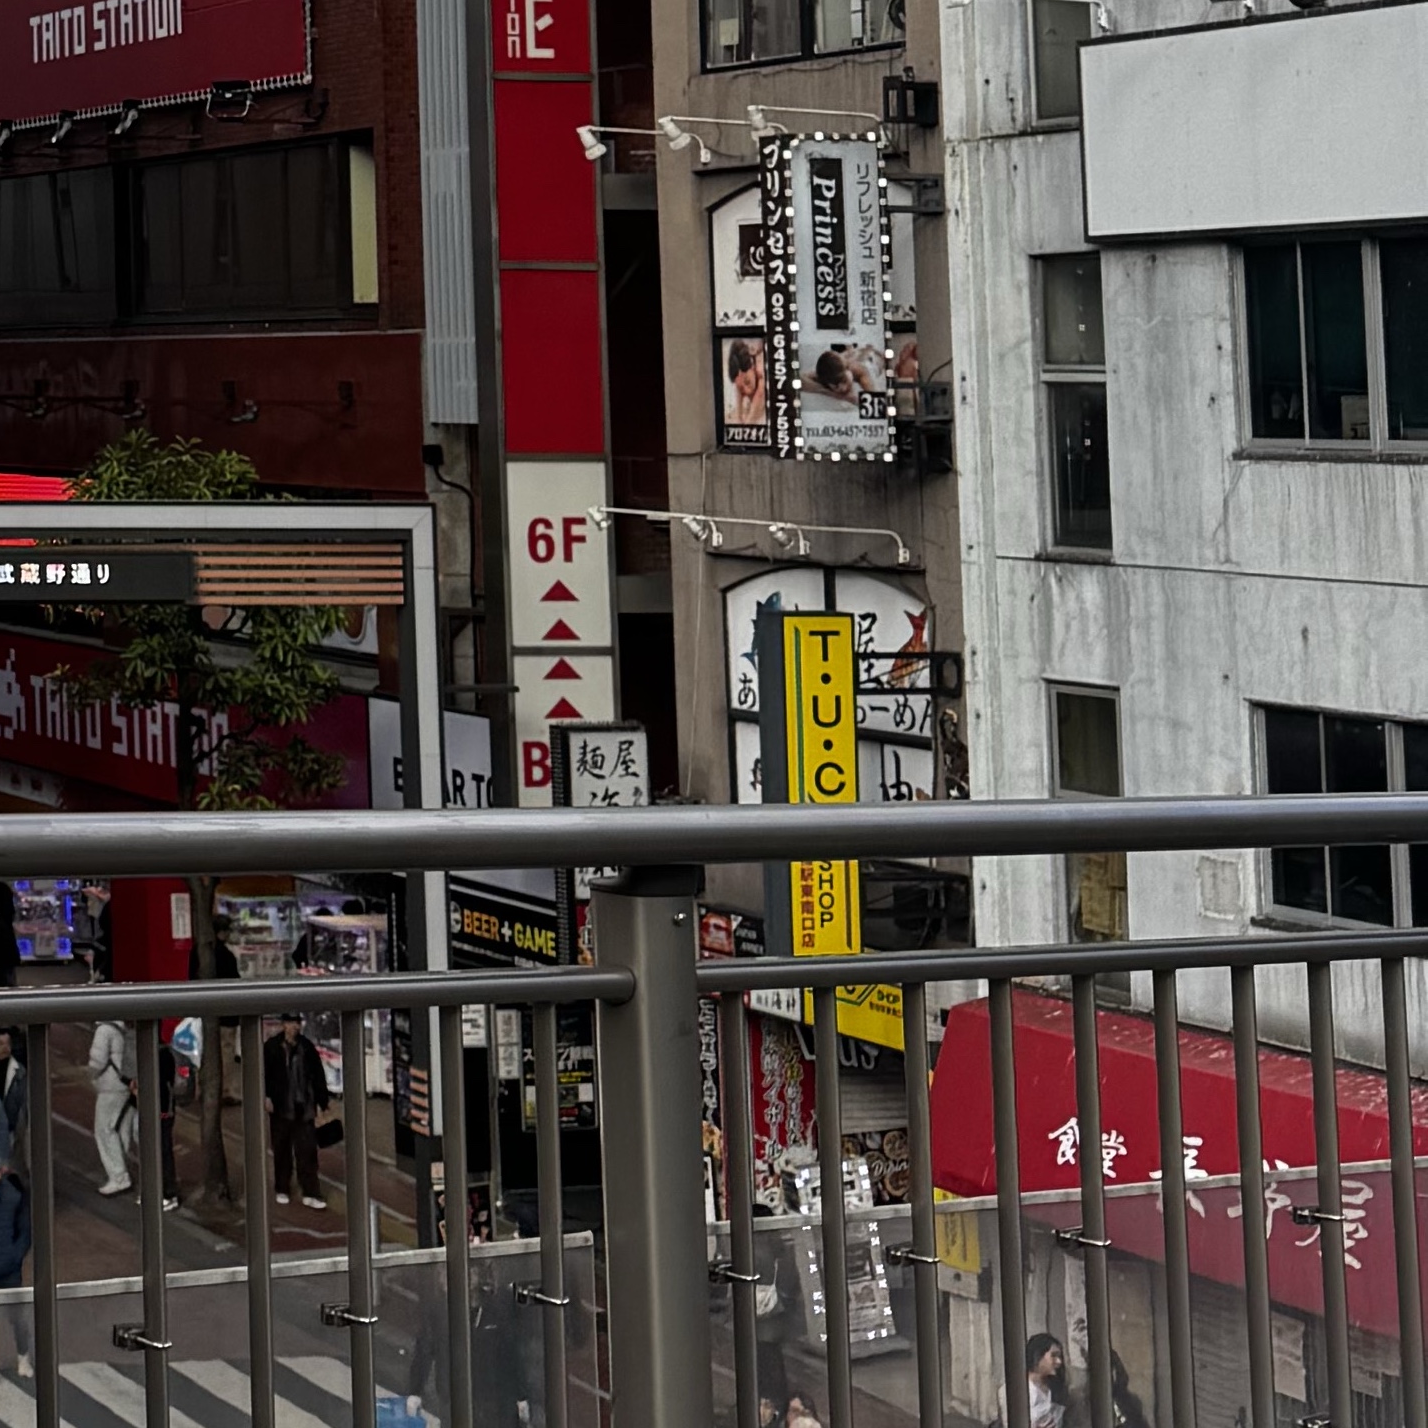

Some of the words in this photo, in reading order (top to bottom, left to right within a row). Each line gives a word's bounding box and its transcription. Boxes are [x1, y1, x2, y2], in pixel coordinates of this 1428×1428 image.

[28, 4, 88, 64] TAITO
[762, 139, 787, 285] プリンセス
[812, 175, 838, 317] Princess
[859, 271, 878, 326] 新宿店
[771, 292, 789, 459] 03-6457-7557
[860, 392, 885, 419] 3F
[526, 516, 588, 564] 6F
[575, 739, 640, 781] 麺屋
[463, 908, 500, 943] BEER
[514, 922, 557, 958] GAME
